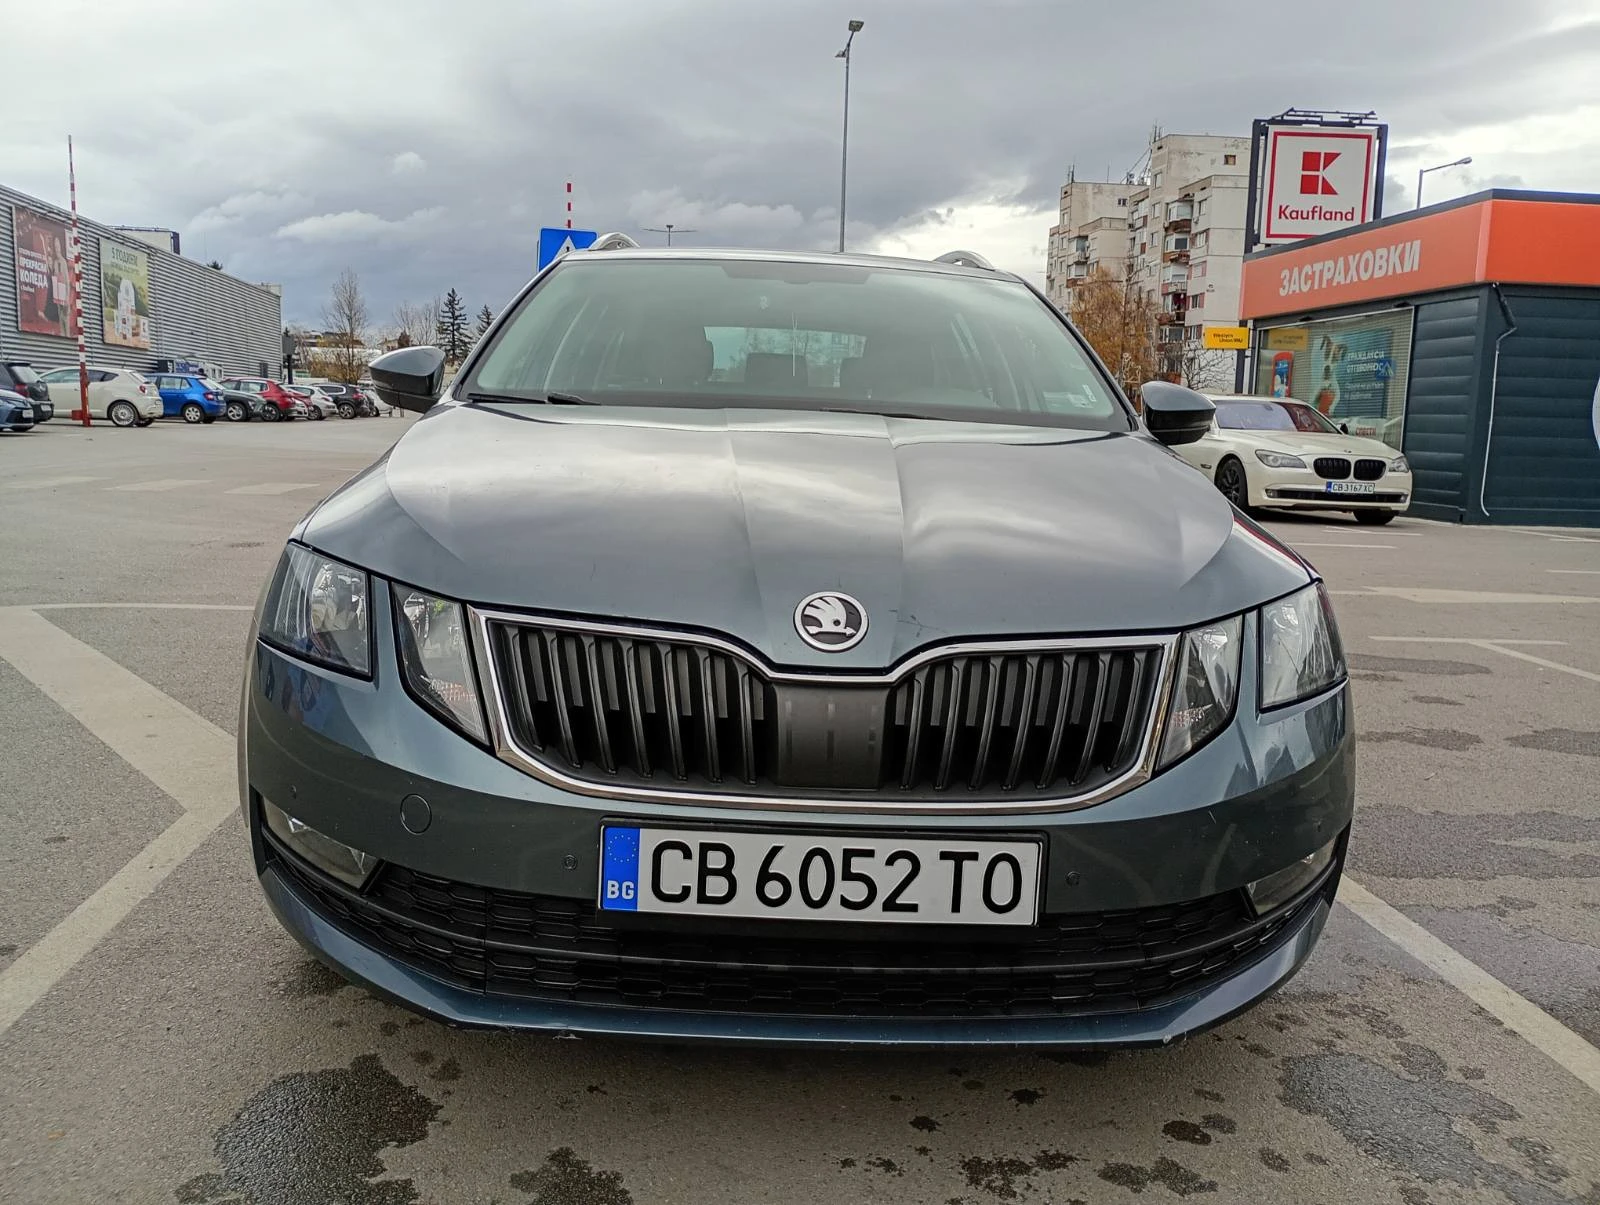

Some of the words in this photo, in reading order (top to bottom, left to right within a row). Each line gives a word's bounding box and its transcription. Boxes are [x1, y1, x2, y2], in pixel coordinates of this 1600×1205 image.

[1278, 205, 1355, 221] Kaufland
[1279, 239, 1421, 297] ЗАСТРАХОВКИ
[19, 270, 49, 289] КОЛЕДА
[1332, 483, 1343, 491] CB
[1344, 484, 1363, 492] 3167
[651, 840, 737, 905] CB
[755, 845, 921, 912] 6052
[939, 850, 1023, 914] TO
[607, 880, 634, 899] BG
